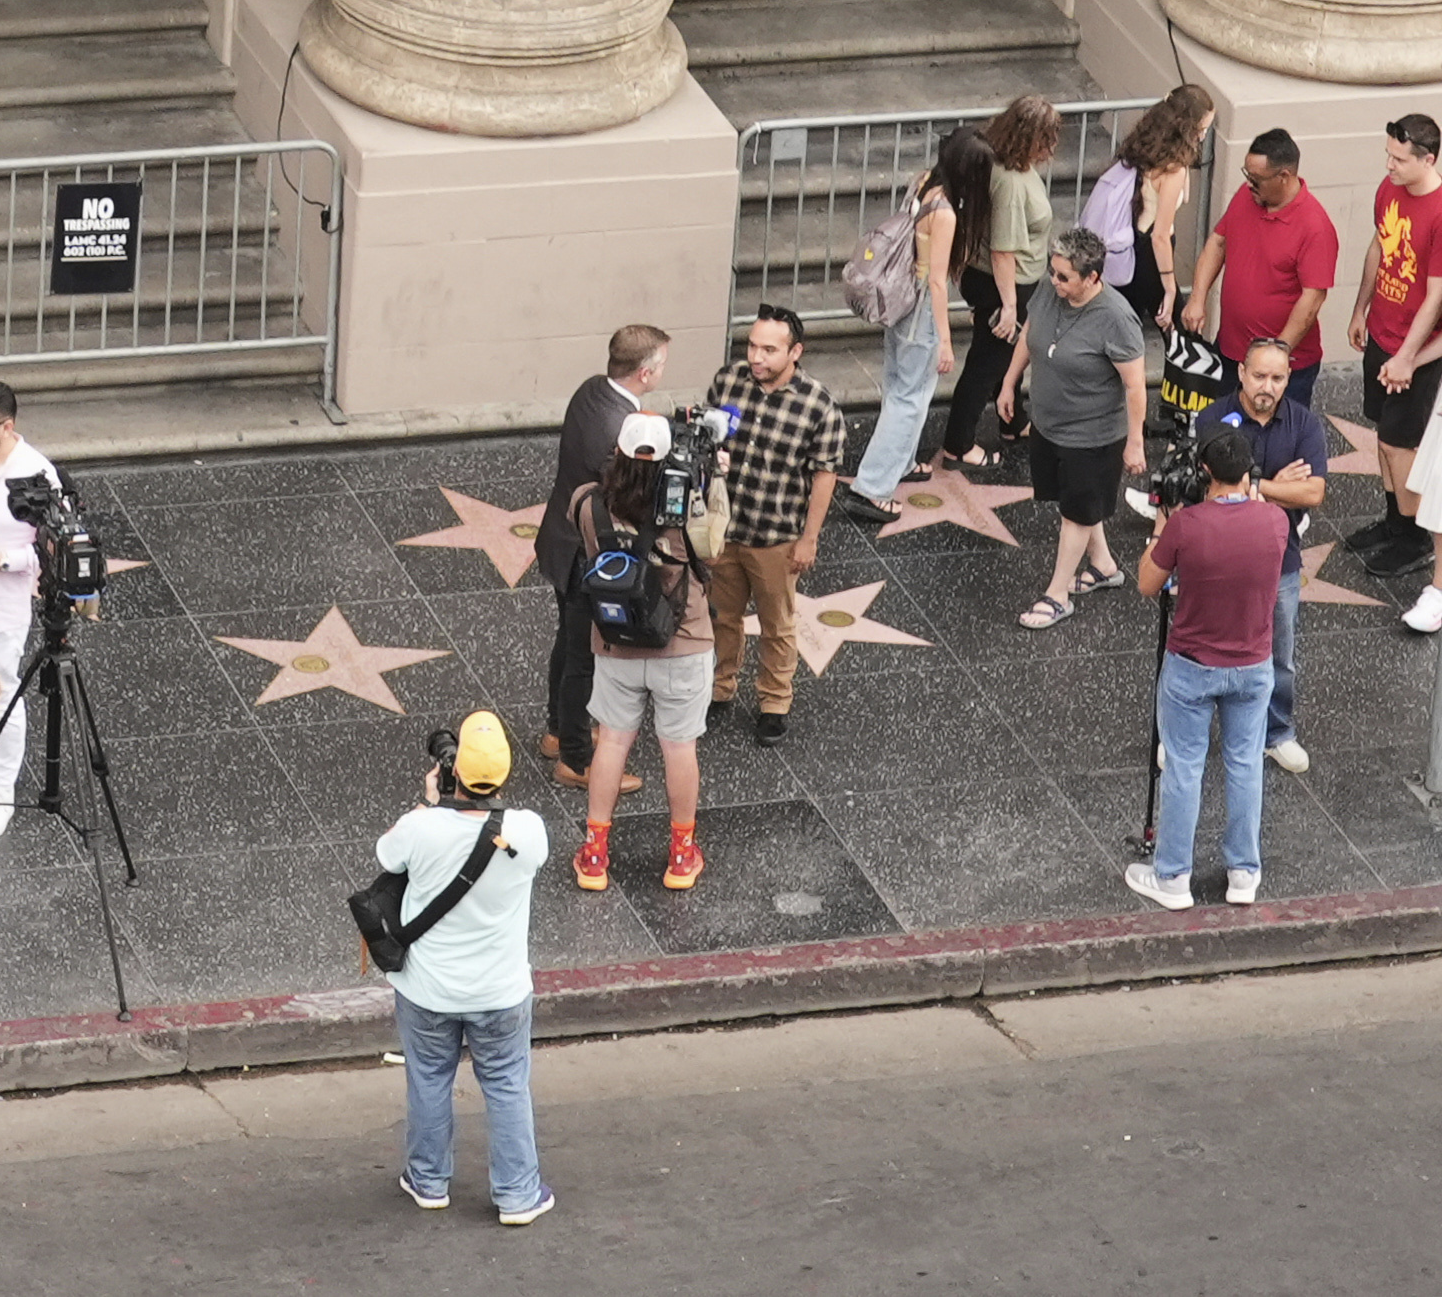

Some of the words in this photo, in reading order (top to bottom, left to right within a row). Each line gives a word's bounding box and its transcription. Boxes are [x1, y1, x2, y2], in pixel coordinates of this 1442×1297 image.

[82, 197, 115, 220] NO
[63, 217, 130, 232] TRESPASSING
[64, 235, 97, 246] LAMC
[63, 246, 85, 257] 602
